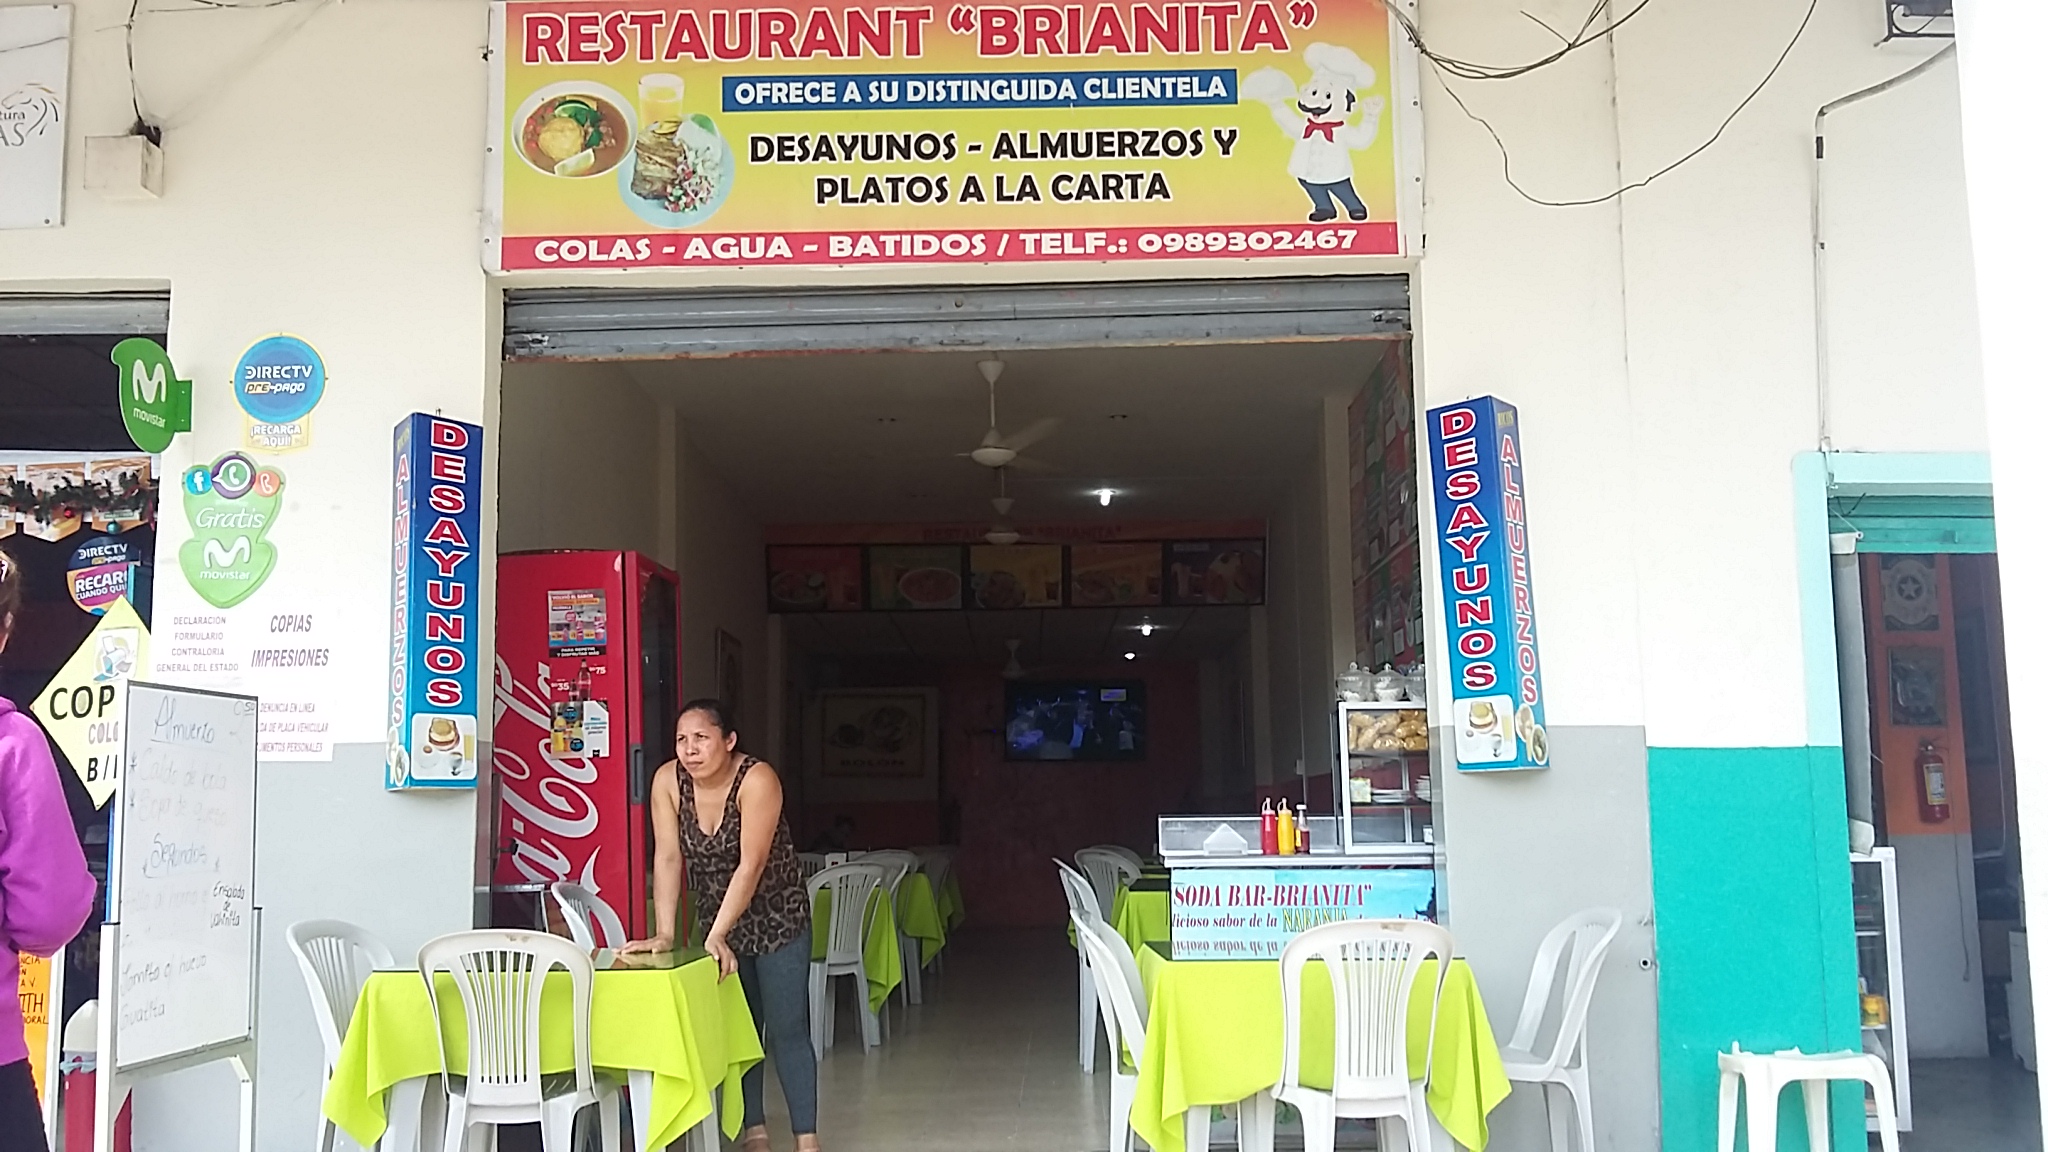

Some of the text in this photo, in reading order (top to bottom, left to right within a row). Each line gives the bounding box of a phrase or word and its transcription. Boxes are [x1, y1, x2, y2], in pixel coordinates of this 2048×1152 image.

[523, 9, 931, 63] RESTAURANT
[735, 76, 1228, 104] OFRECE A SU DISTINGUIDA CLIENTELA
[750, 132, 957, 163] DESAYUNOS
[992, 128, 1203, 160] ALMUERZOS
[1214, 129, 1238, 155] Y
[817, 172, 1170, 204] PLATOS A LA CARTA
[535, 238, 651, 263] COLAS
[683, 236, 793, 260] AGUA
[829, 233, 986, 258] BATIDOS
[997, 233, 1008, 257] /
[1020, 232, 1128, 255] TELF.:
[1137, 229, 1357, 253] 0989302467
[245, 365, 313, 379] DIRECTV
[133, 406, 166, 428] movistar
[196, 507, 265, 530] Gratis
[78, 543, 128, 560] DIRECTV
[1439, 409, 1498, 691] DESAYUNOS
[423, 418, 470, 708] DESAYUNOS
[1500, 433, 1537, 706] ALMUERZOS
[199, 569, 250, 580] movistar
[392, 453, 410, 727] ALMUERZOS
[270, 615, 313, 633] COPIAS
[174, 632, 224, 641] FORMULARIO
[171, 648, 225, 656] CONTRALORIA
[251, 648, 330, 668] IMPRESIONES
[156, 663, 239, 672] GENERAL DEL ESTADO
[1213, 912, 1246, 928] sabor
[1249, 912, 1263, 928] de
[1266, 912, 1278, 928] la
